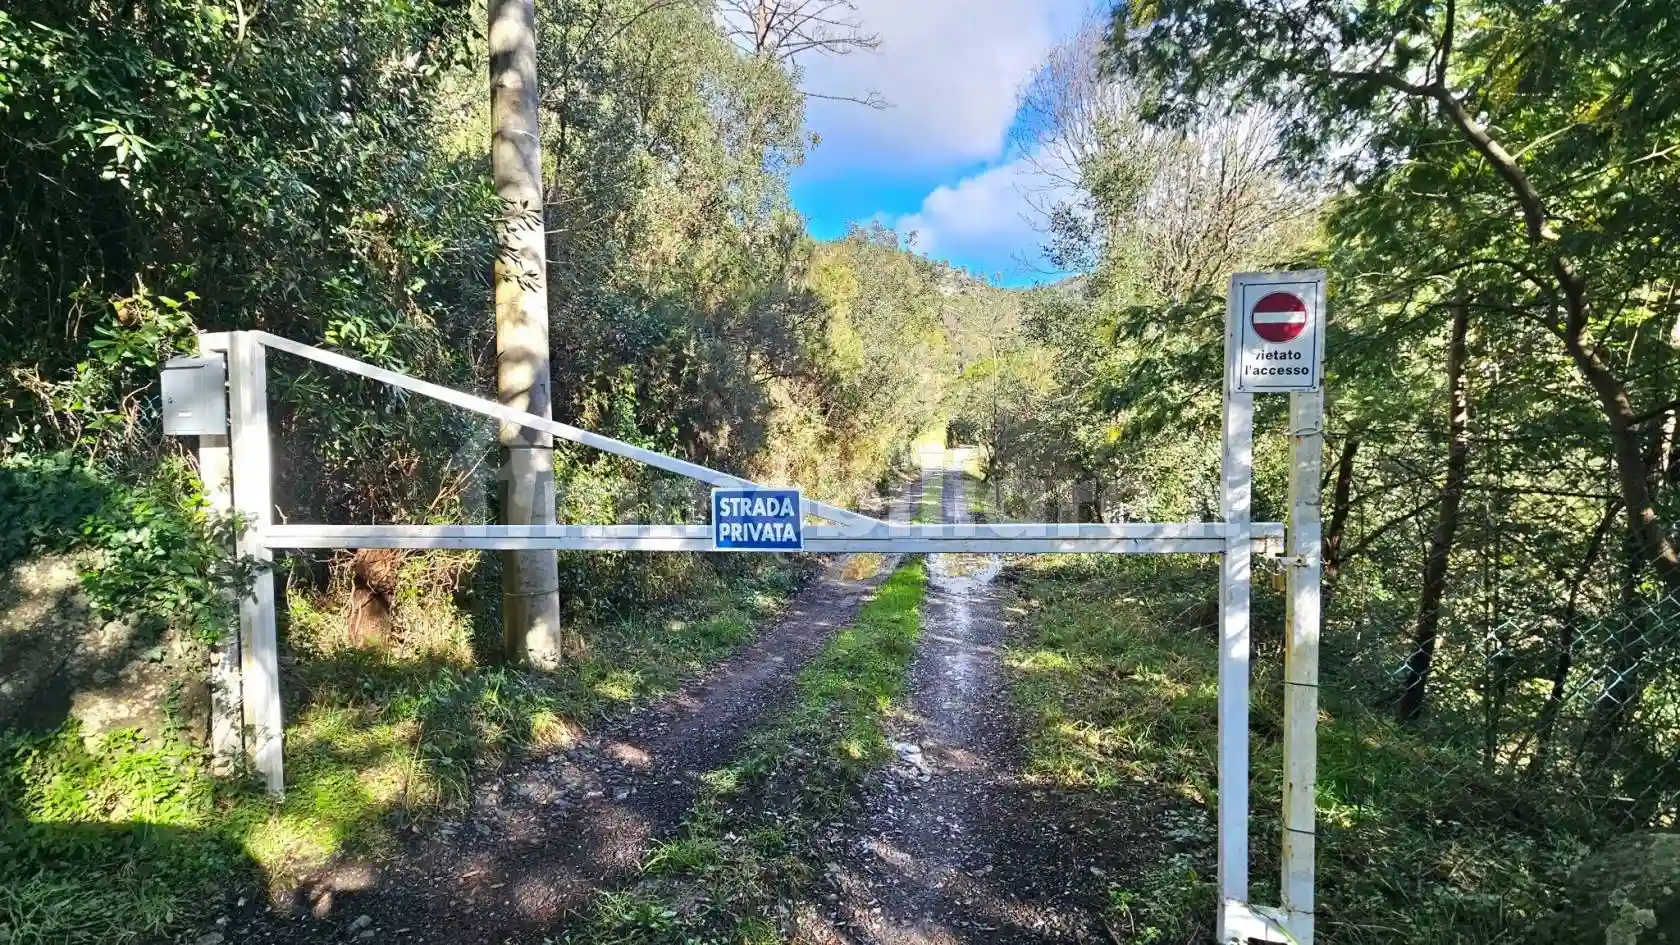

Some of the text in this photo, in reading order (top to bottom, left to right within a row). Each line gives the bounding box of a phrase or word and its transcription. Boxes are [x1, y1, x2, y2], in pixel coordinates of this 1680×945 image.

[1245, 365, 1310, 375] l'accesso
[719, 497, 795, 516] STRADA
[719, 522, 798, 542] PRIVATA
